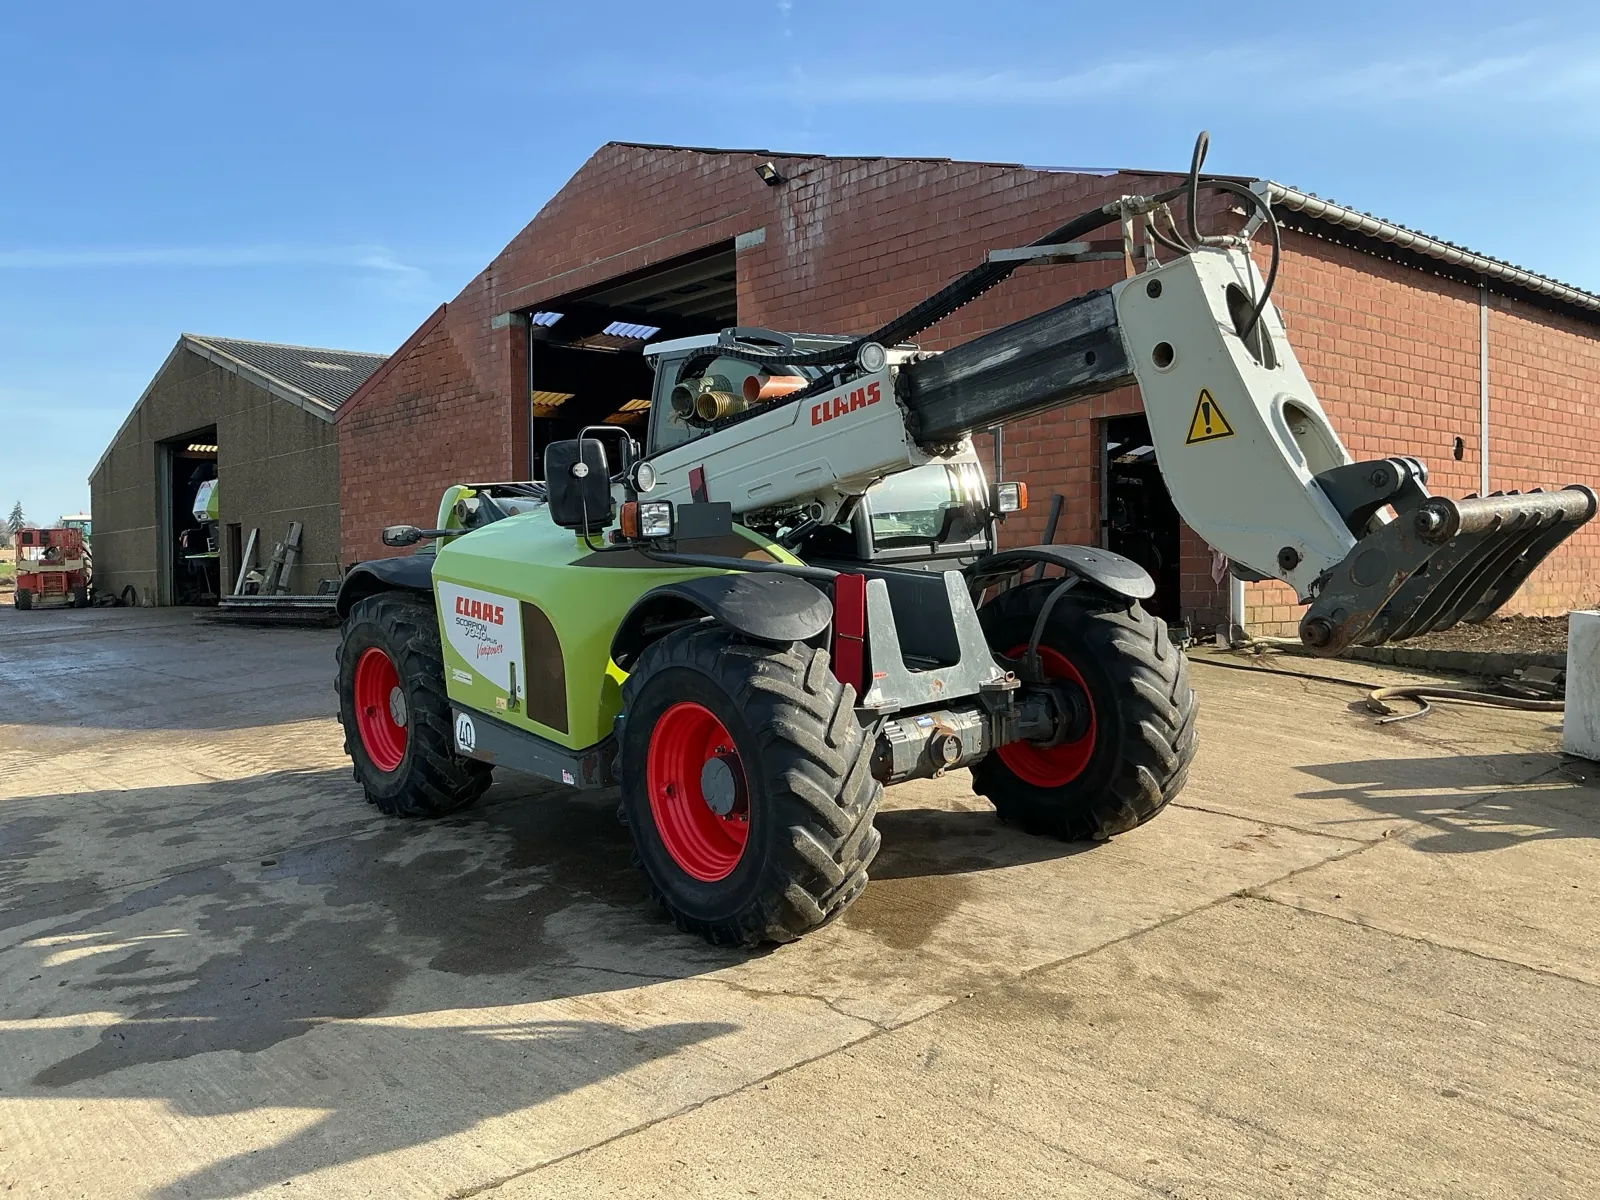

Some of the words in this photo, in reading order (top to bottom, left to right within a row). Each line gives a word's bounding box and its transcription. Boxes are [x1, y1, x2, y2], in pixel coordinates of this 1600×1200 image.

[811, 381, 881, 426] CLAAS
[456, 596, 504, 626] CLAAS
[455, 617, 487, 632] SCORPION
[464, 627, 487, 641] 7040
[459, 720, 472, 746] 40
